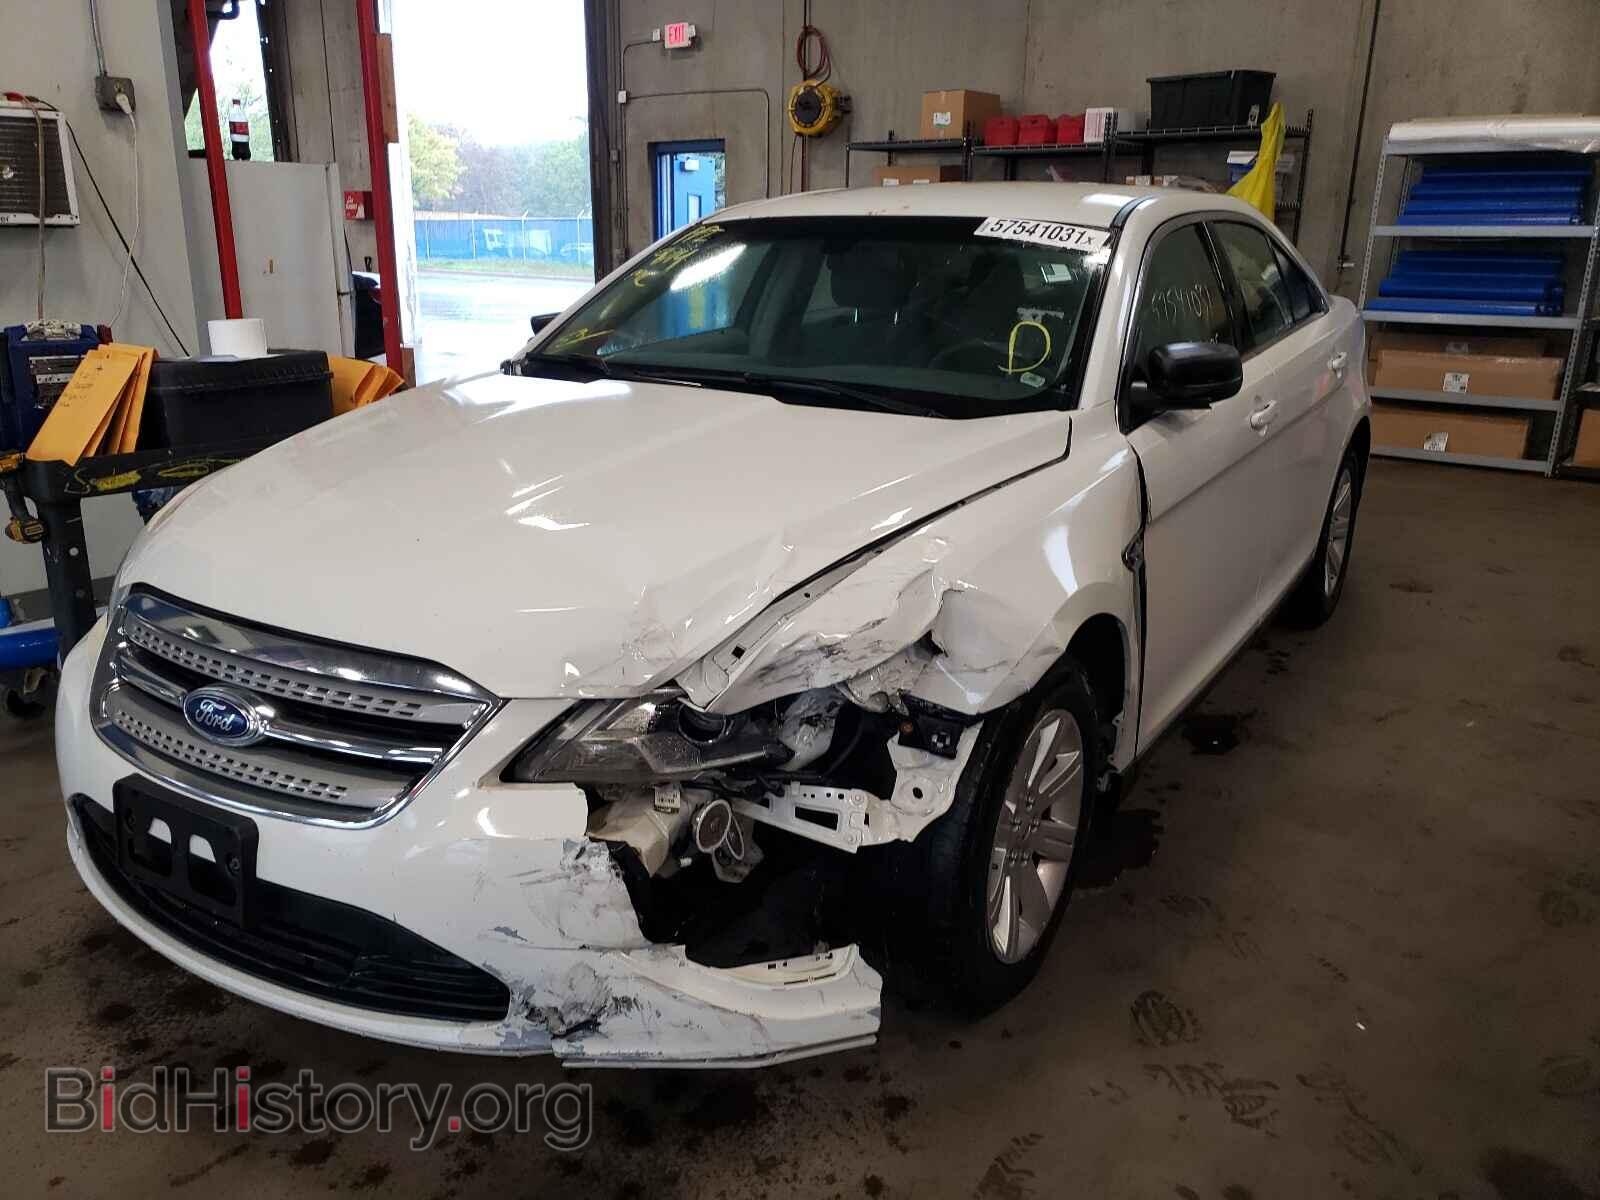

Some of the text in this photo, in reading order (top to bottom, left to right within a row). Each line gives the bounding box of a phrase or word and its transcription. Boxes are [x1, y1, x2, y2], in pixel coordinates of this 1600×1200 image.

[668, 24, 686, 44] EXIT
[990, 219, 1087, 245] 57541031
[195, 699, 237, 731] Ford
